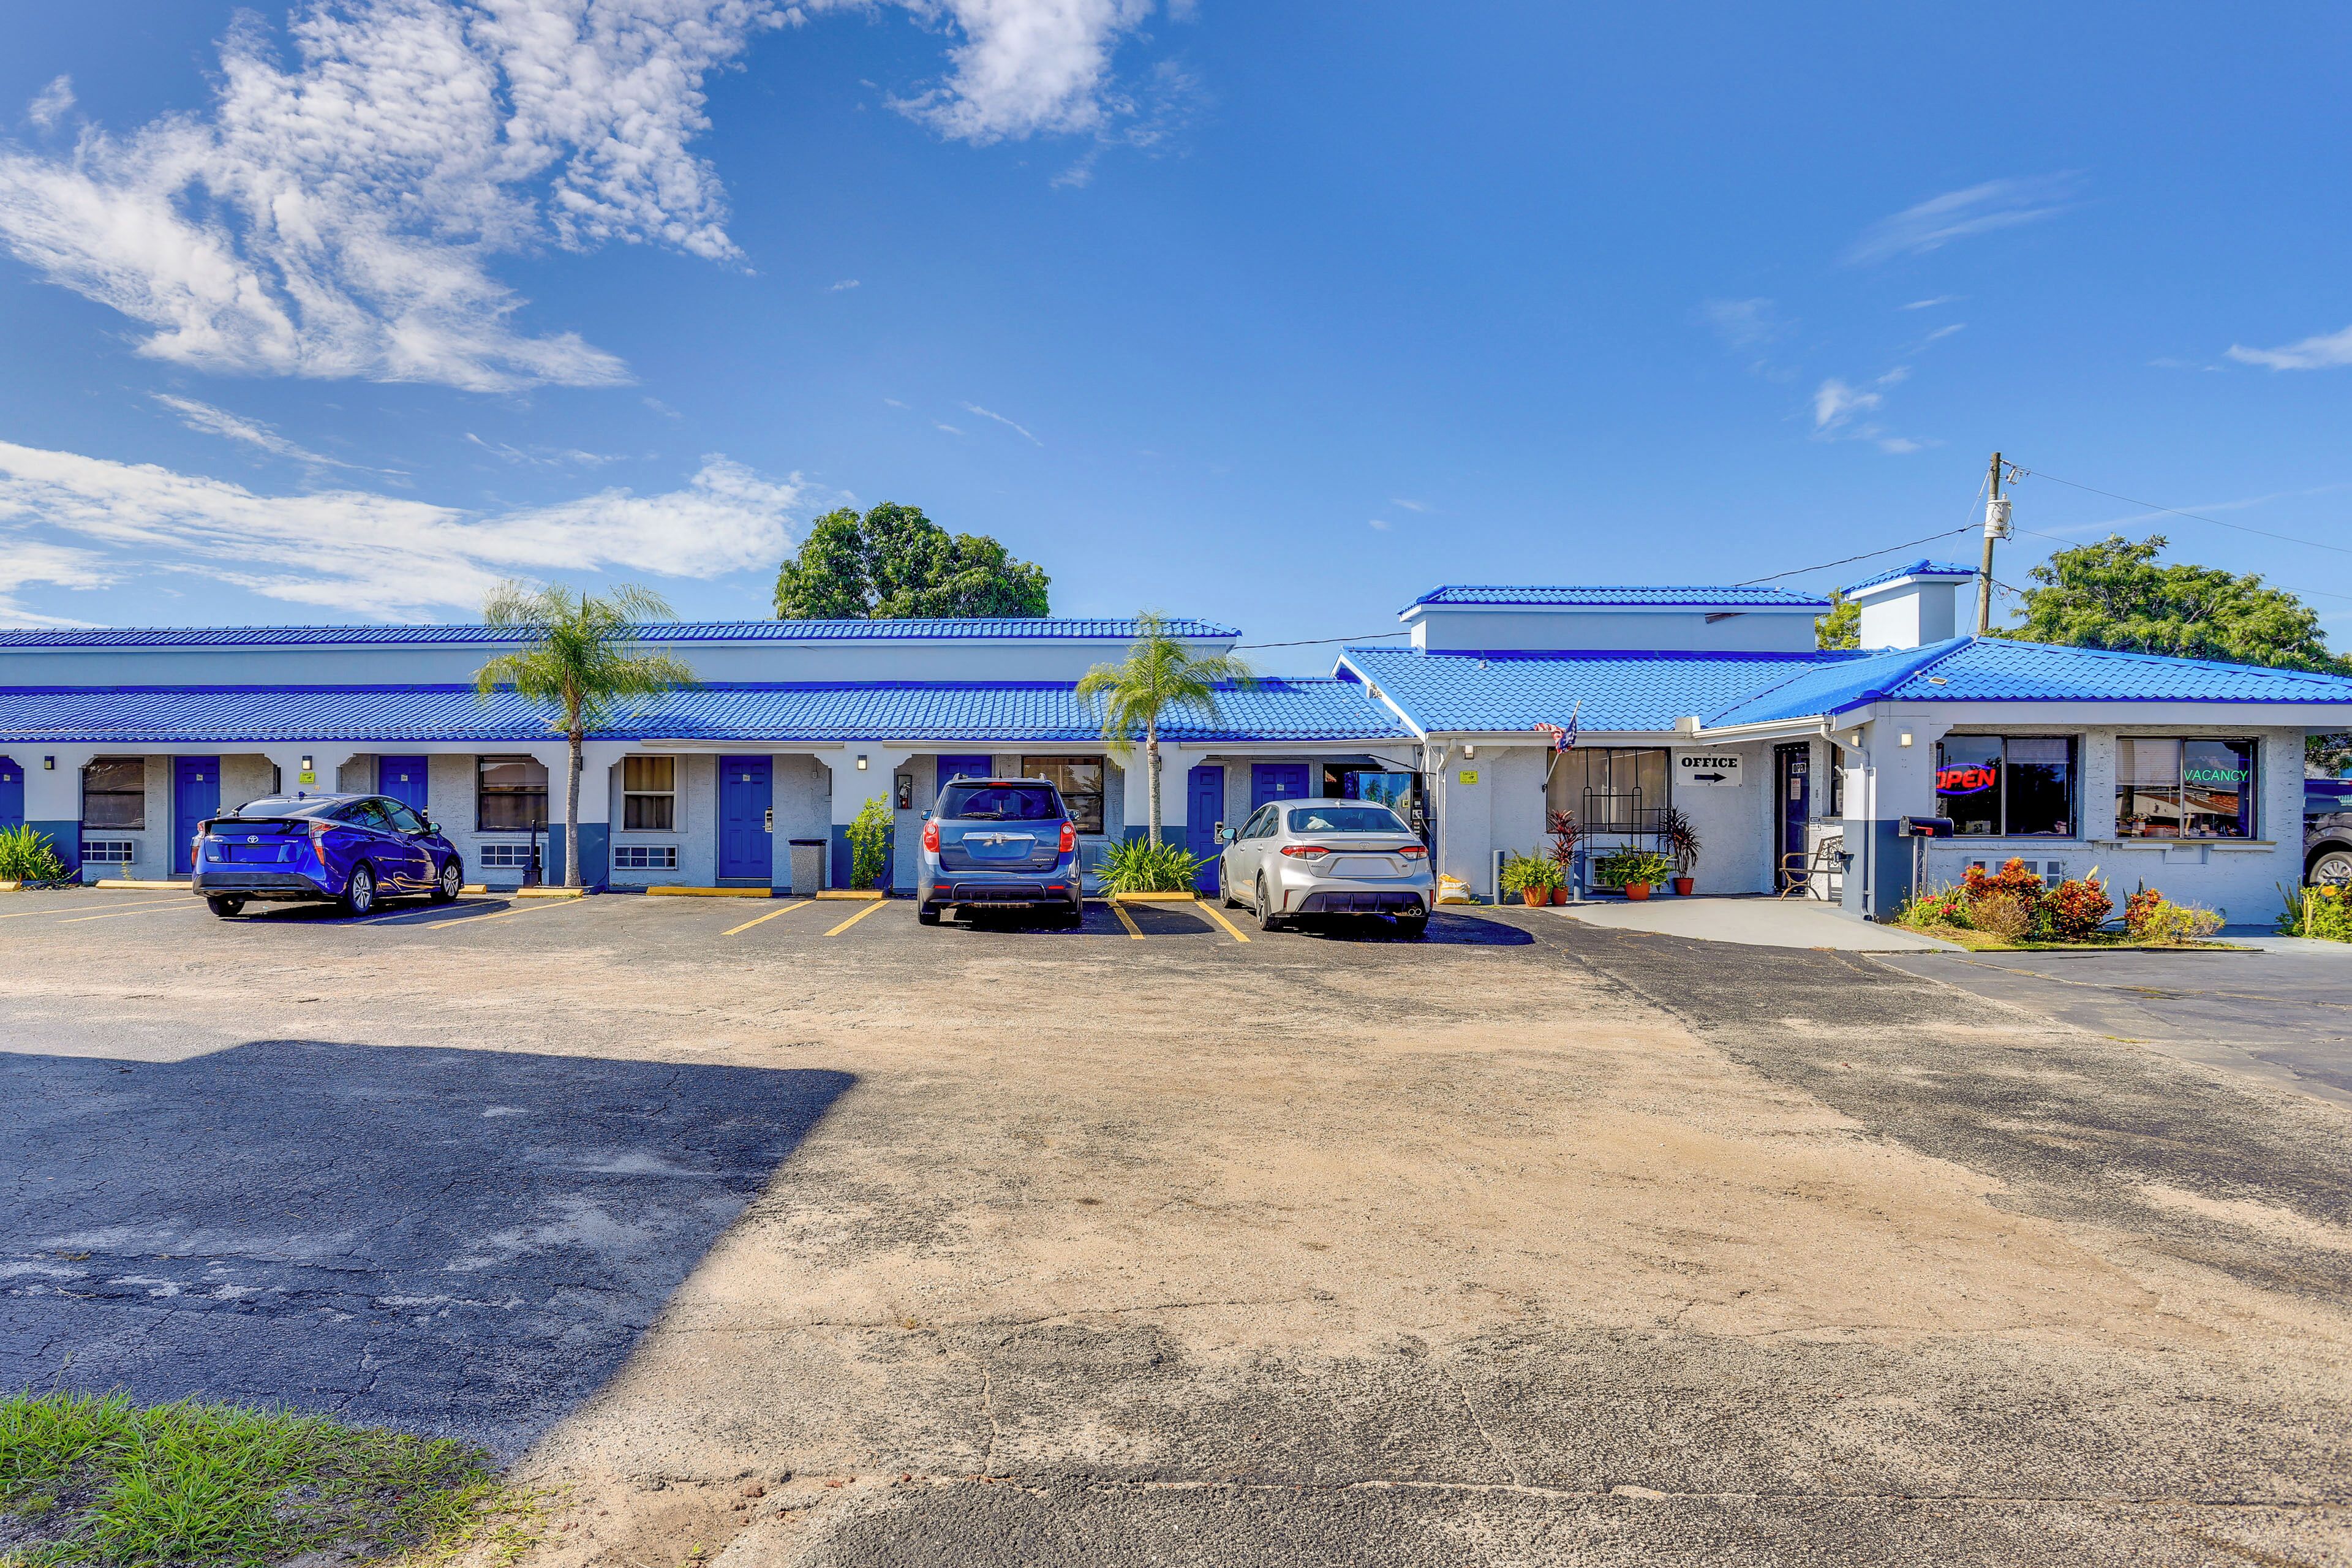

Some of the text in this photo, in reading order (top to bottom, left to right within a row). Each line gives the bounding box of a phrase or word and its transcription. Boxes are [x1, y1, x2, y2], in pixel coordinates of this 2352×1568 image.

[1681, 757, 1737, 767] OFFICE
[1793, 764, 1806, 772] OPEN
[2184, 769, 2248, 781] VACANCY
